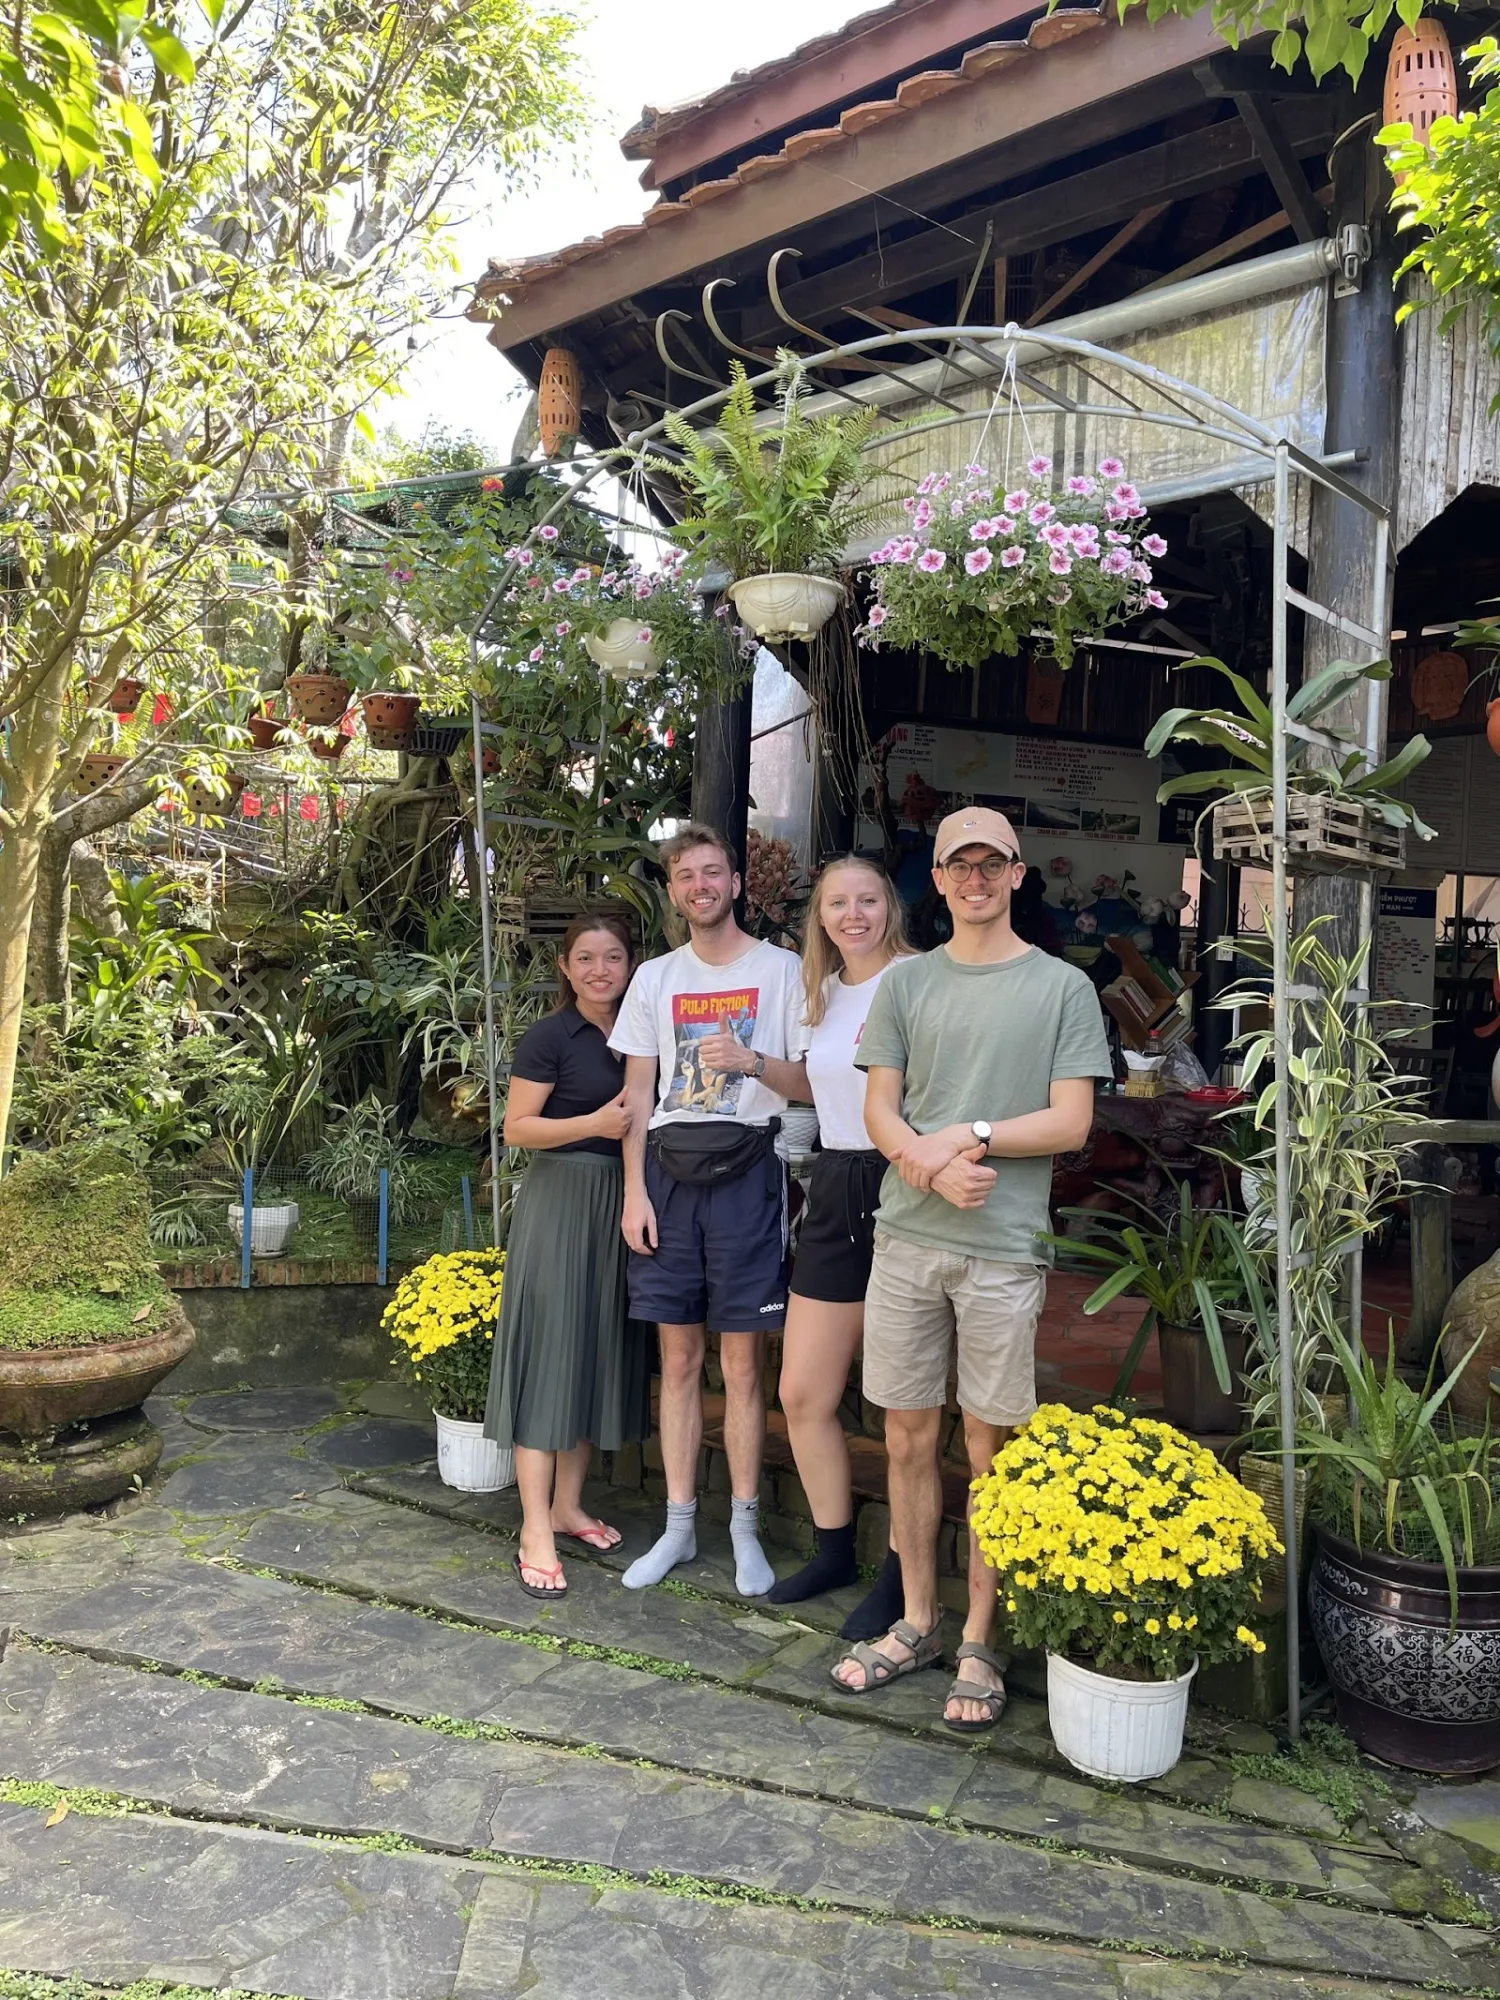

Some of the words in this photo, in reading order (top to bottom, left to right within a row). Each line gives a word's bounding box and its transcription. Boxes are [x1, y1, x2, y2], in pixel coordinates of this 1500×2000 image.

[680, 998, 708, 1015] PULP
[710, 994, 750, 1014] FICTION
[759, 1303, 785, 1314] adidas
[1452, 1645, 1476, 1665] 福
